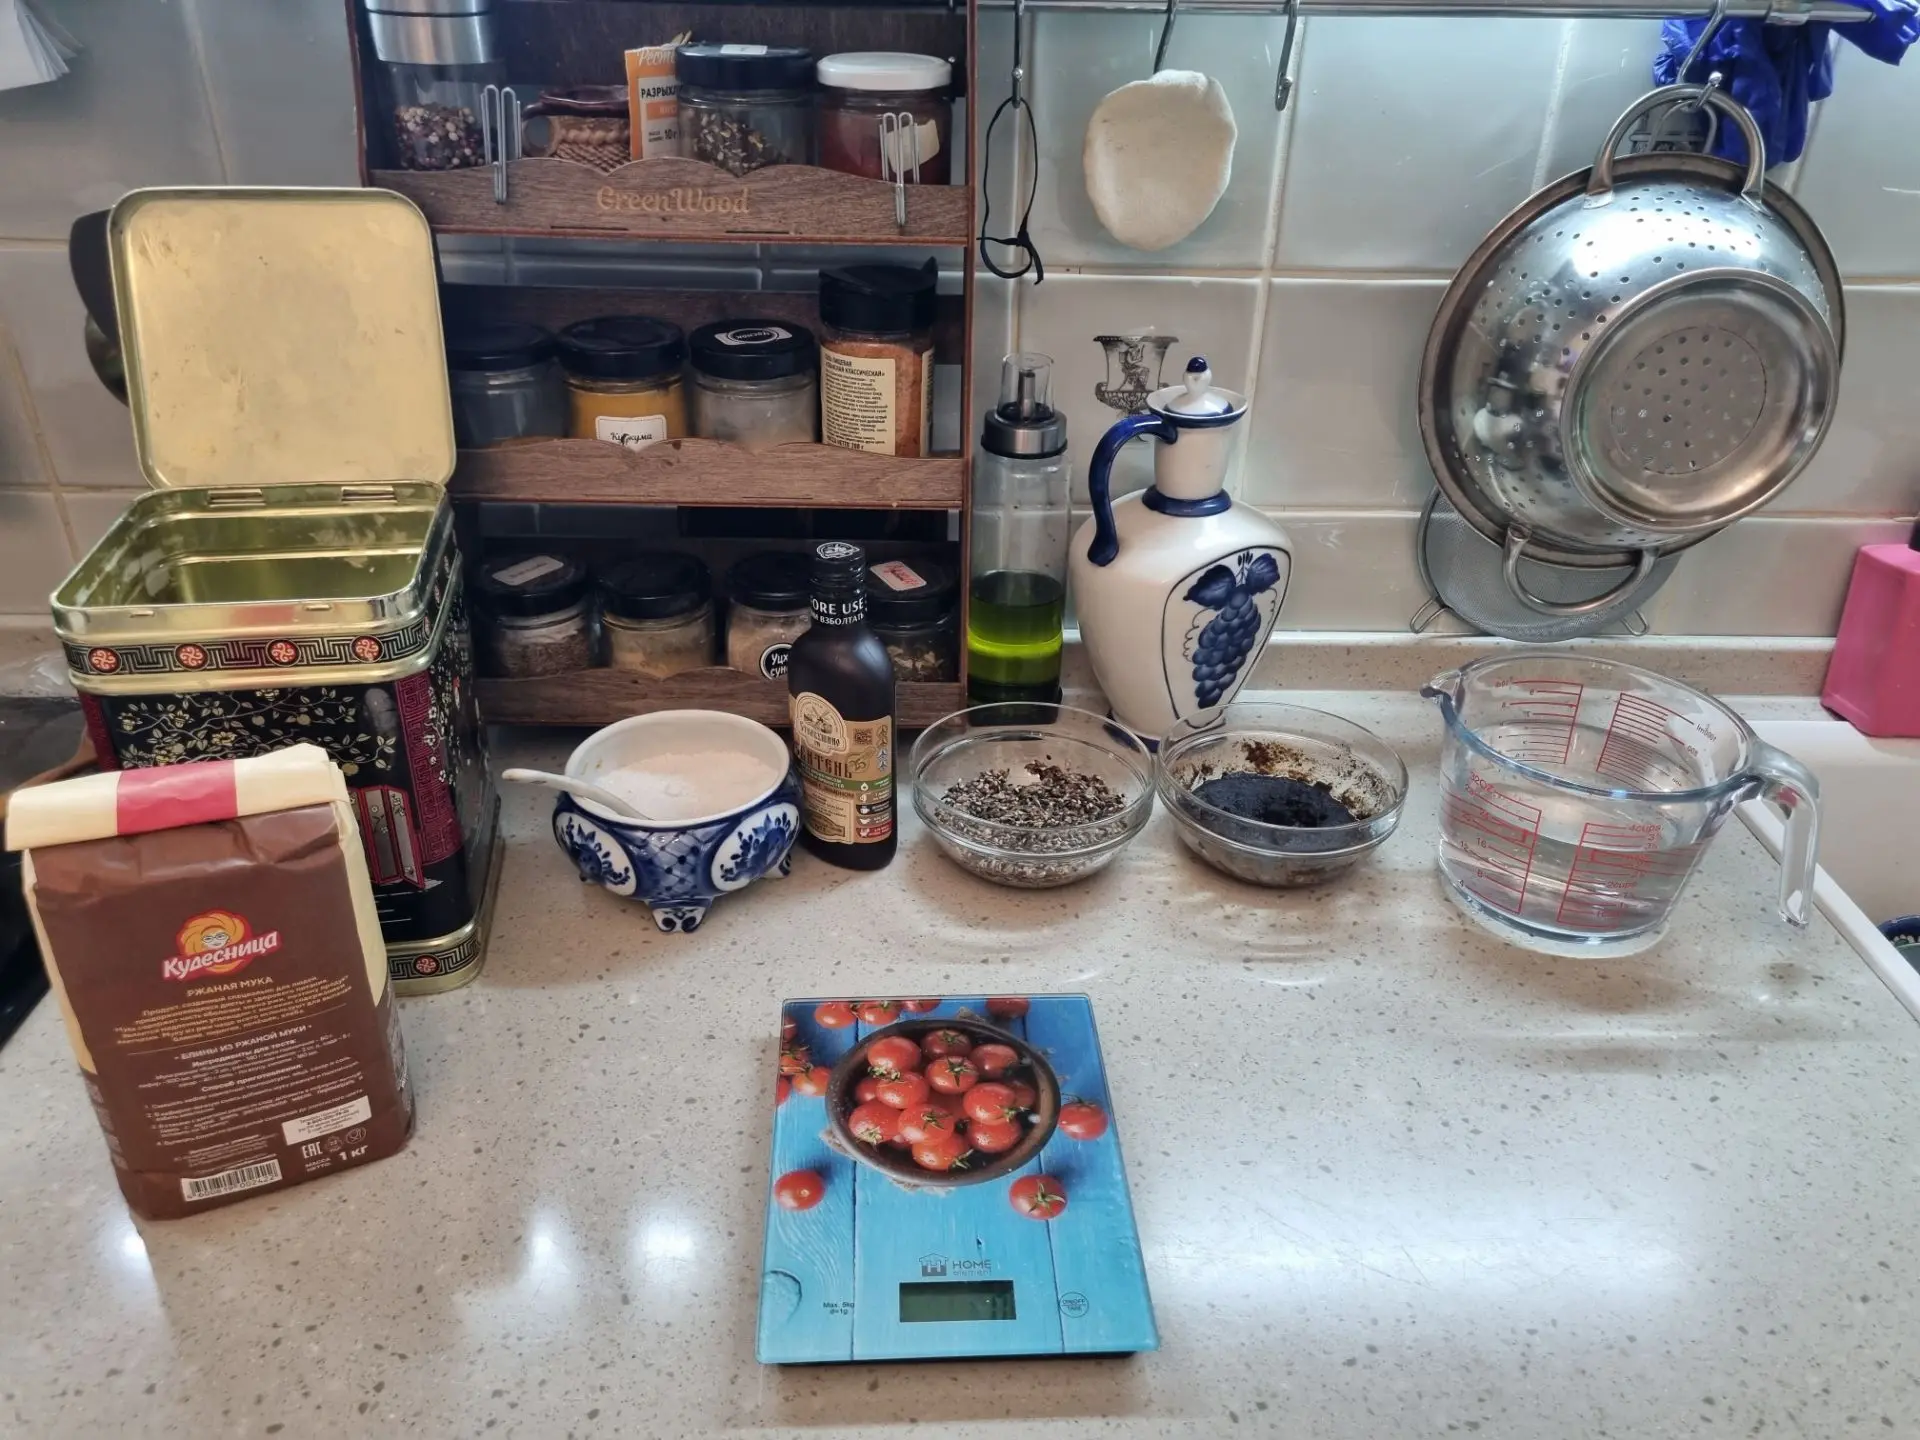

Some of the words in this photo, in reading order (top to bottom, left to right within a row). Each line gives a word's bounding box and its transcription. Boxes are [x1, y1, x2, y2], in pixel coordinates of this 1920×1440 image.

[842, 598, 864, 614] USE
[1476, 837, 1487, 848] 16
[164, 931, 278, 979] Кудесница
[186, 982, 238, 998] РЖАНАЯ
[240, 976, 274, 989] МУКА
[181, 1048, 218, 1060] БЛИНЫ
[220, 1043, 233, 1052] ИЗ
[235, 1031, 277, 1049] РЖАНОЙ
[279, 1025, 306, 1038] МУКИ
[339, 1151, 347, 1162] 1
[351, 1145, 369, 1157] кг
[953, 1260, 991, 1270] HOME
[823, 1301, 840, 1309] Max.
[842, 1301, 855, 1310] 5kg
